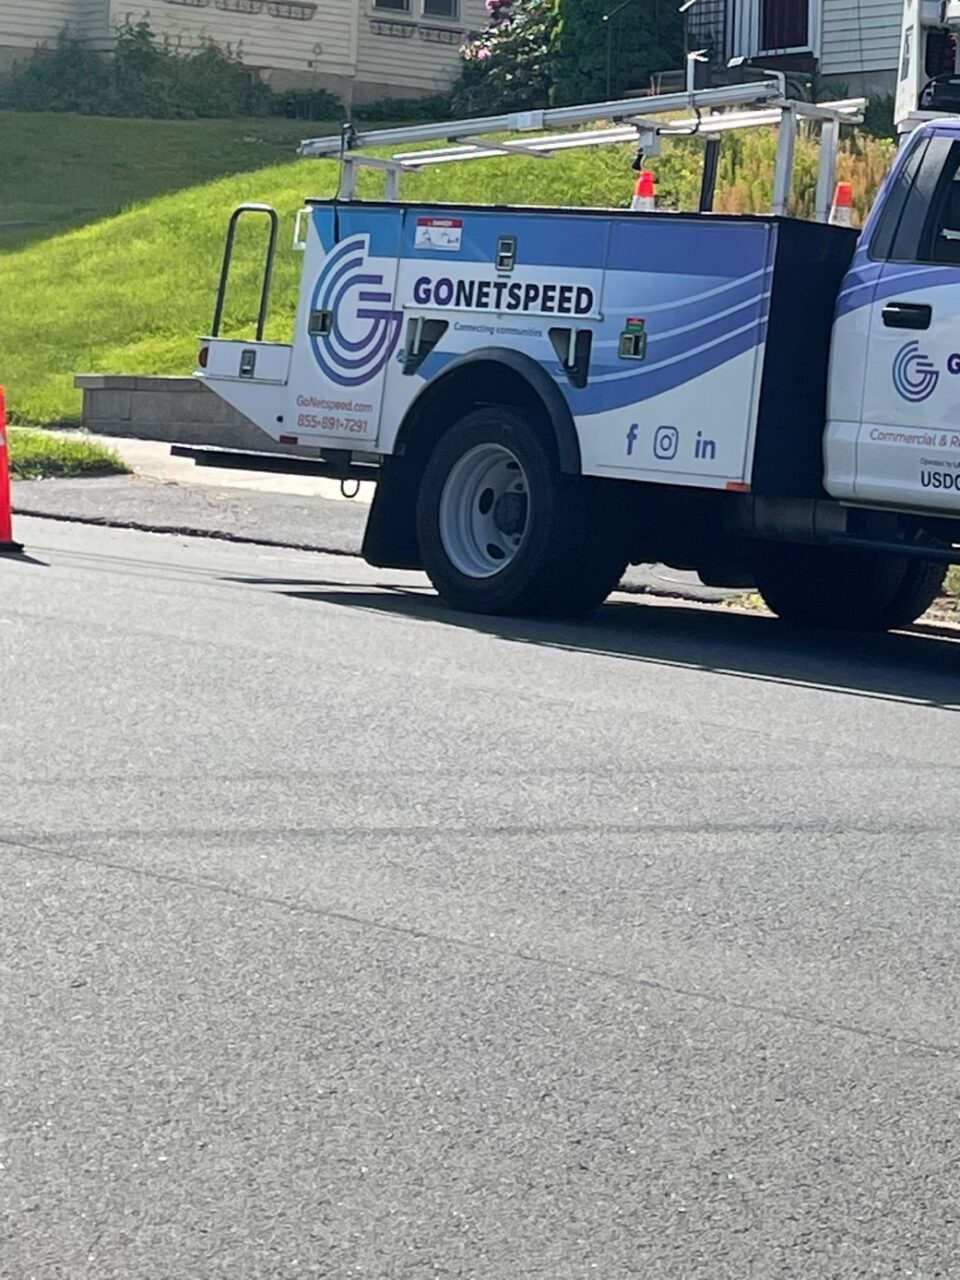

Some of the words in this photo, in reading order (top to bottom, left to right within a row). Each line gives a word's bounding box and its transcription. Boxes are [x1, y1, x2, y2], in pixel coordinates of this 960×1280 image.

[413, 276, 594, 315] GONETSPEED
[454, 322, 495, 336] Connecting
[496, 326, 542, 338] communities
[869, 428, 937, 447] Commercial
[938, 434, 947, 448] &
